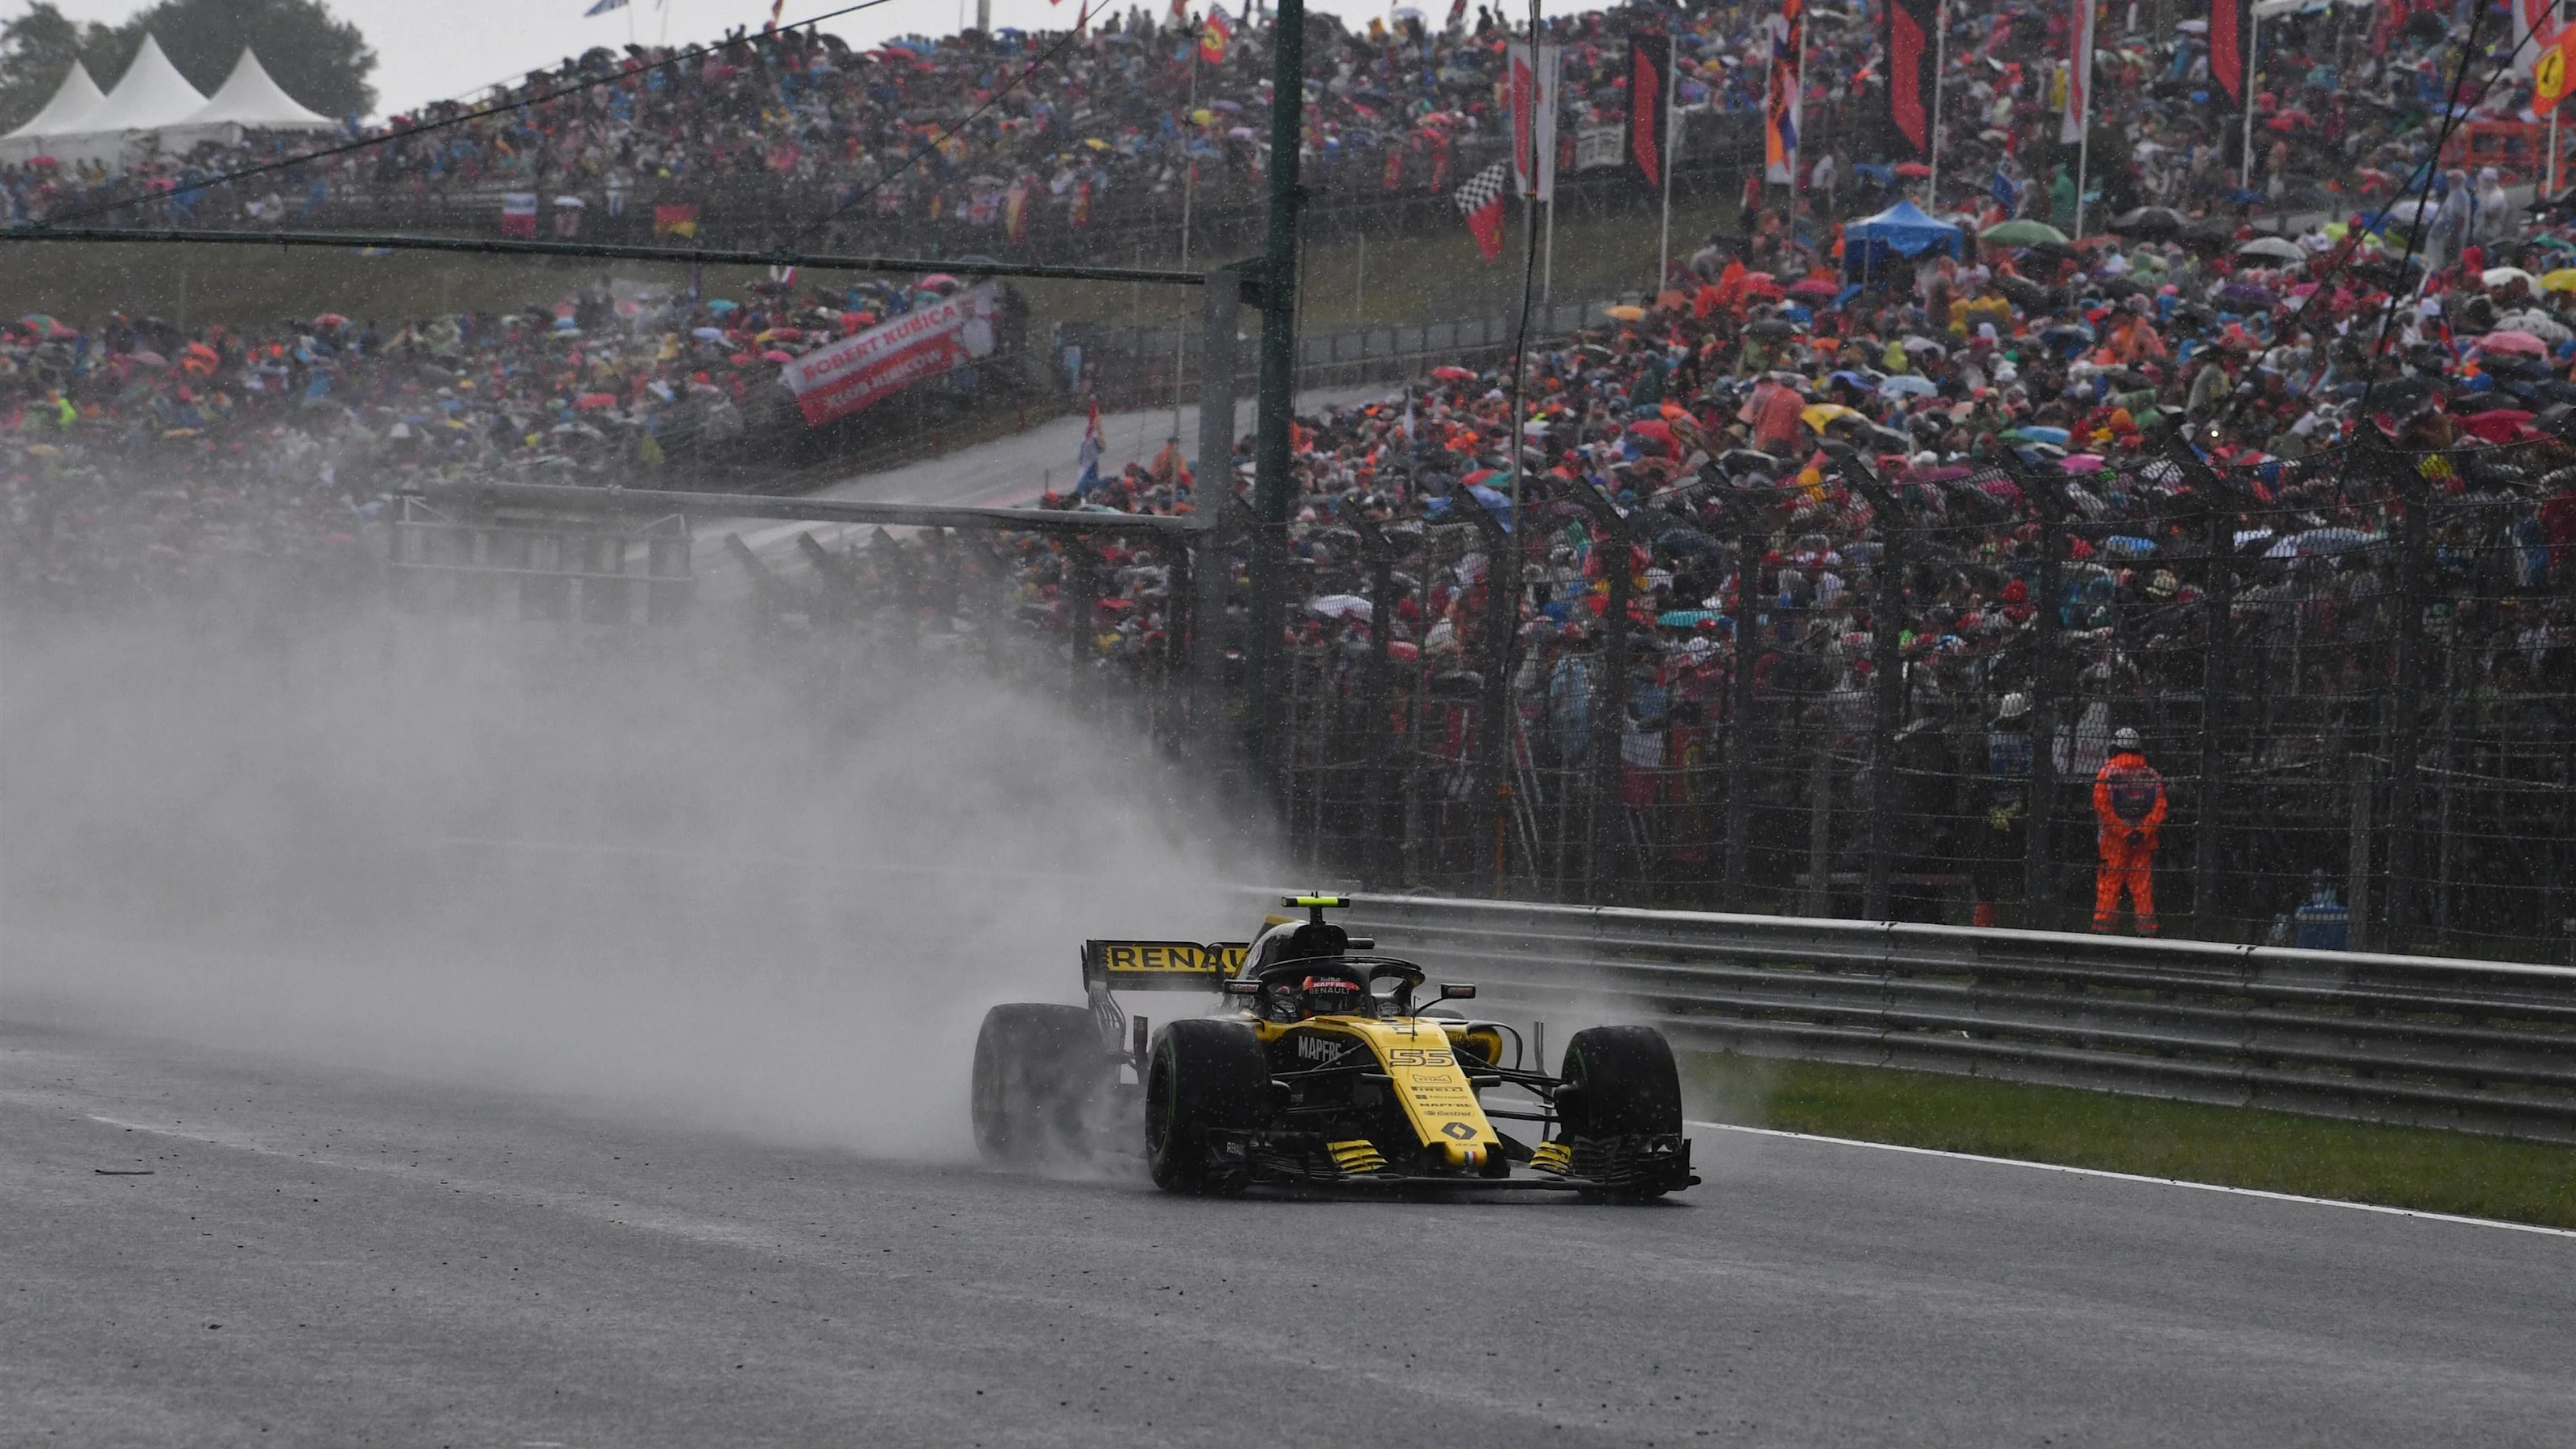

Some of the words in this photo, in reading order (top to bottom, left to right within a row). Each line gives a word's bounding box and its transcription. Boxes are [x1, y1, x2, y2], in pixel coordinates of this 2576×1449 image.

[803, 337, 878, 379] ROBERT
[884, 305, 956, 344] KUBICA
[1308, 986, 1352, 996] RENAULT
[1298, 1034, 1343, 1061] MAPFRE
[1389, 1049, 1455, 1067] 55
